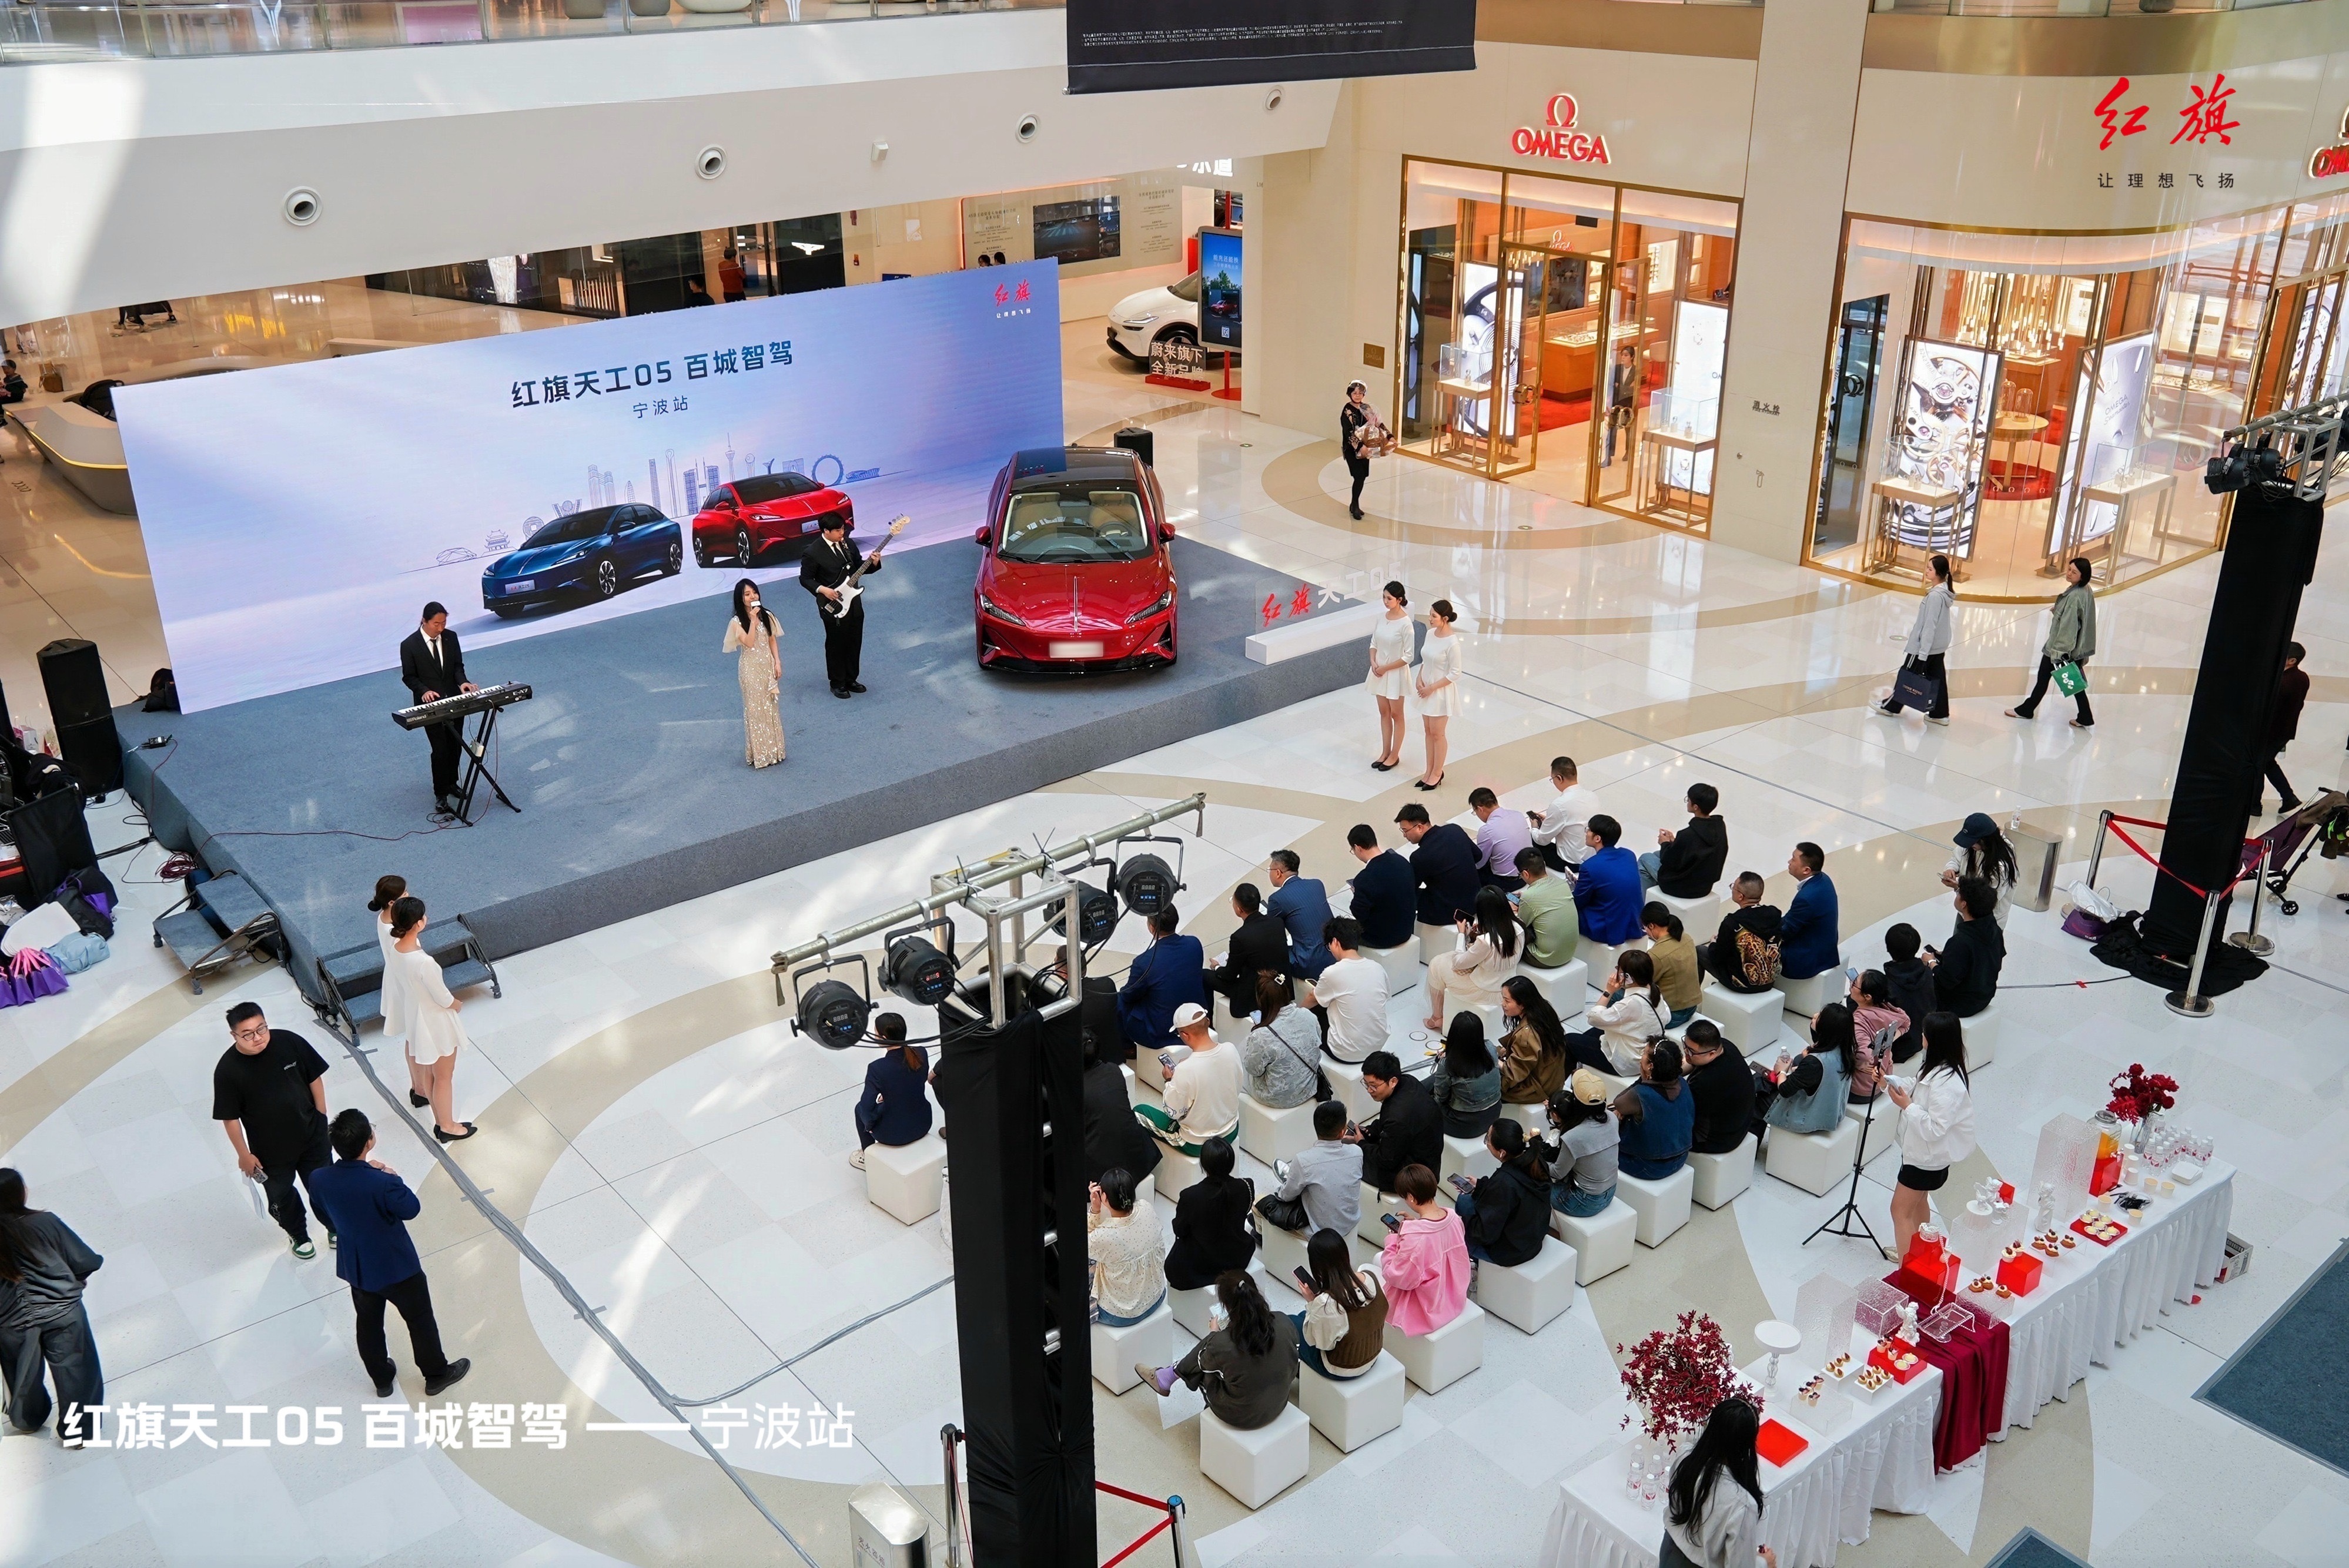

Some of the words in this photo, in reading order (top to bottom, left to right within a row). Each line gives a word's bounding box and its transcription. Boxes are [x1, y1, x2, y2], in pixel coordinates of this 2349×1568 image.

[1511, 127, 1611, 164] OMEGA
[995, 279, 1030, 306] 红旗
[1150, 341, 1203, 363] 蔚来旗下
[511, 360, 671, 408] 红旗天工05
[684, 340, 792, 380] 百城智驾
[633, 395, 688, 418] 宁波站
[2105, 394, 2129, 416] OMEGA
[1262, 582, 1312, 627] 红旗
[513, 688, 528, 696] E-A7
[411, 714, 427, 722] Roland
